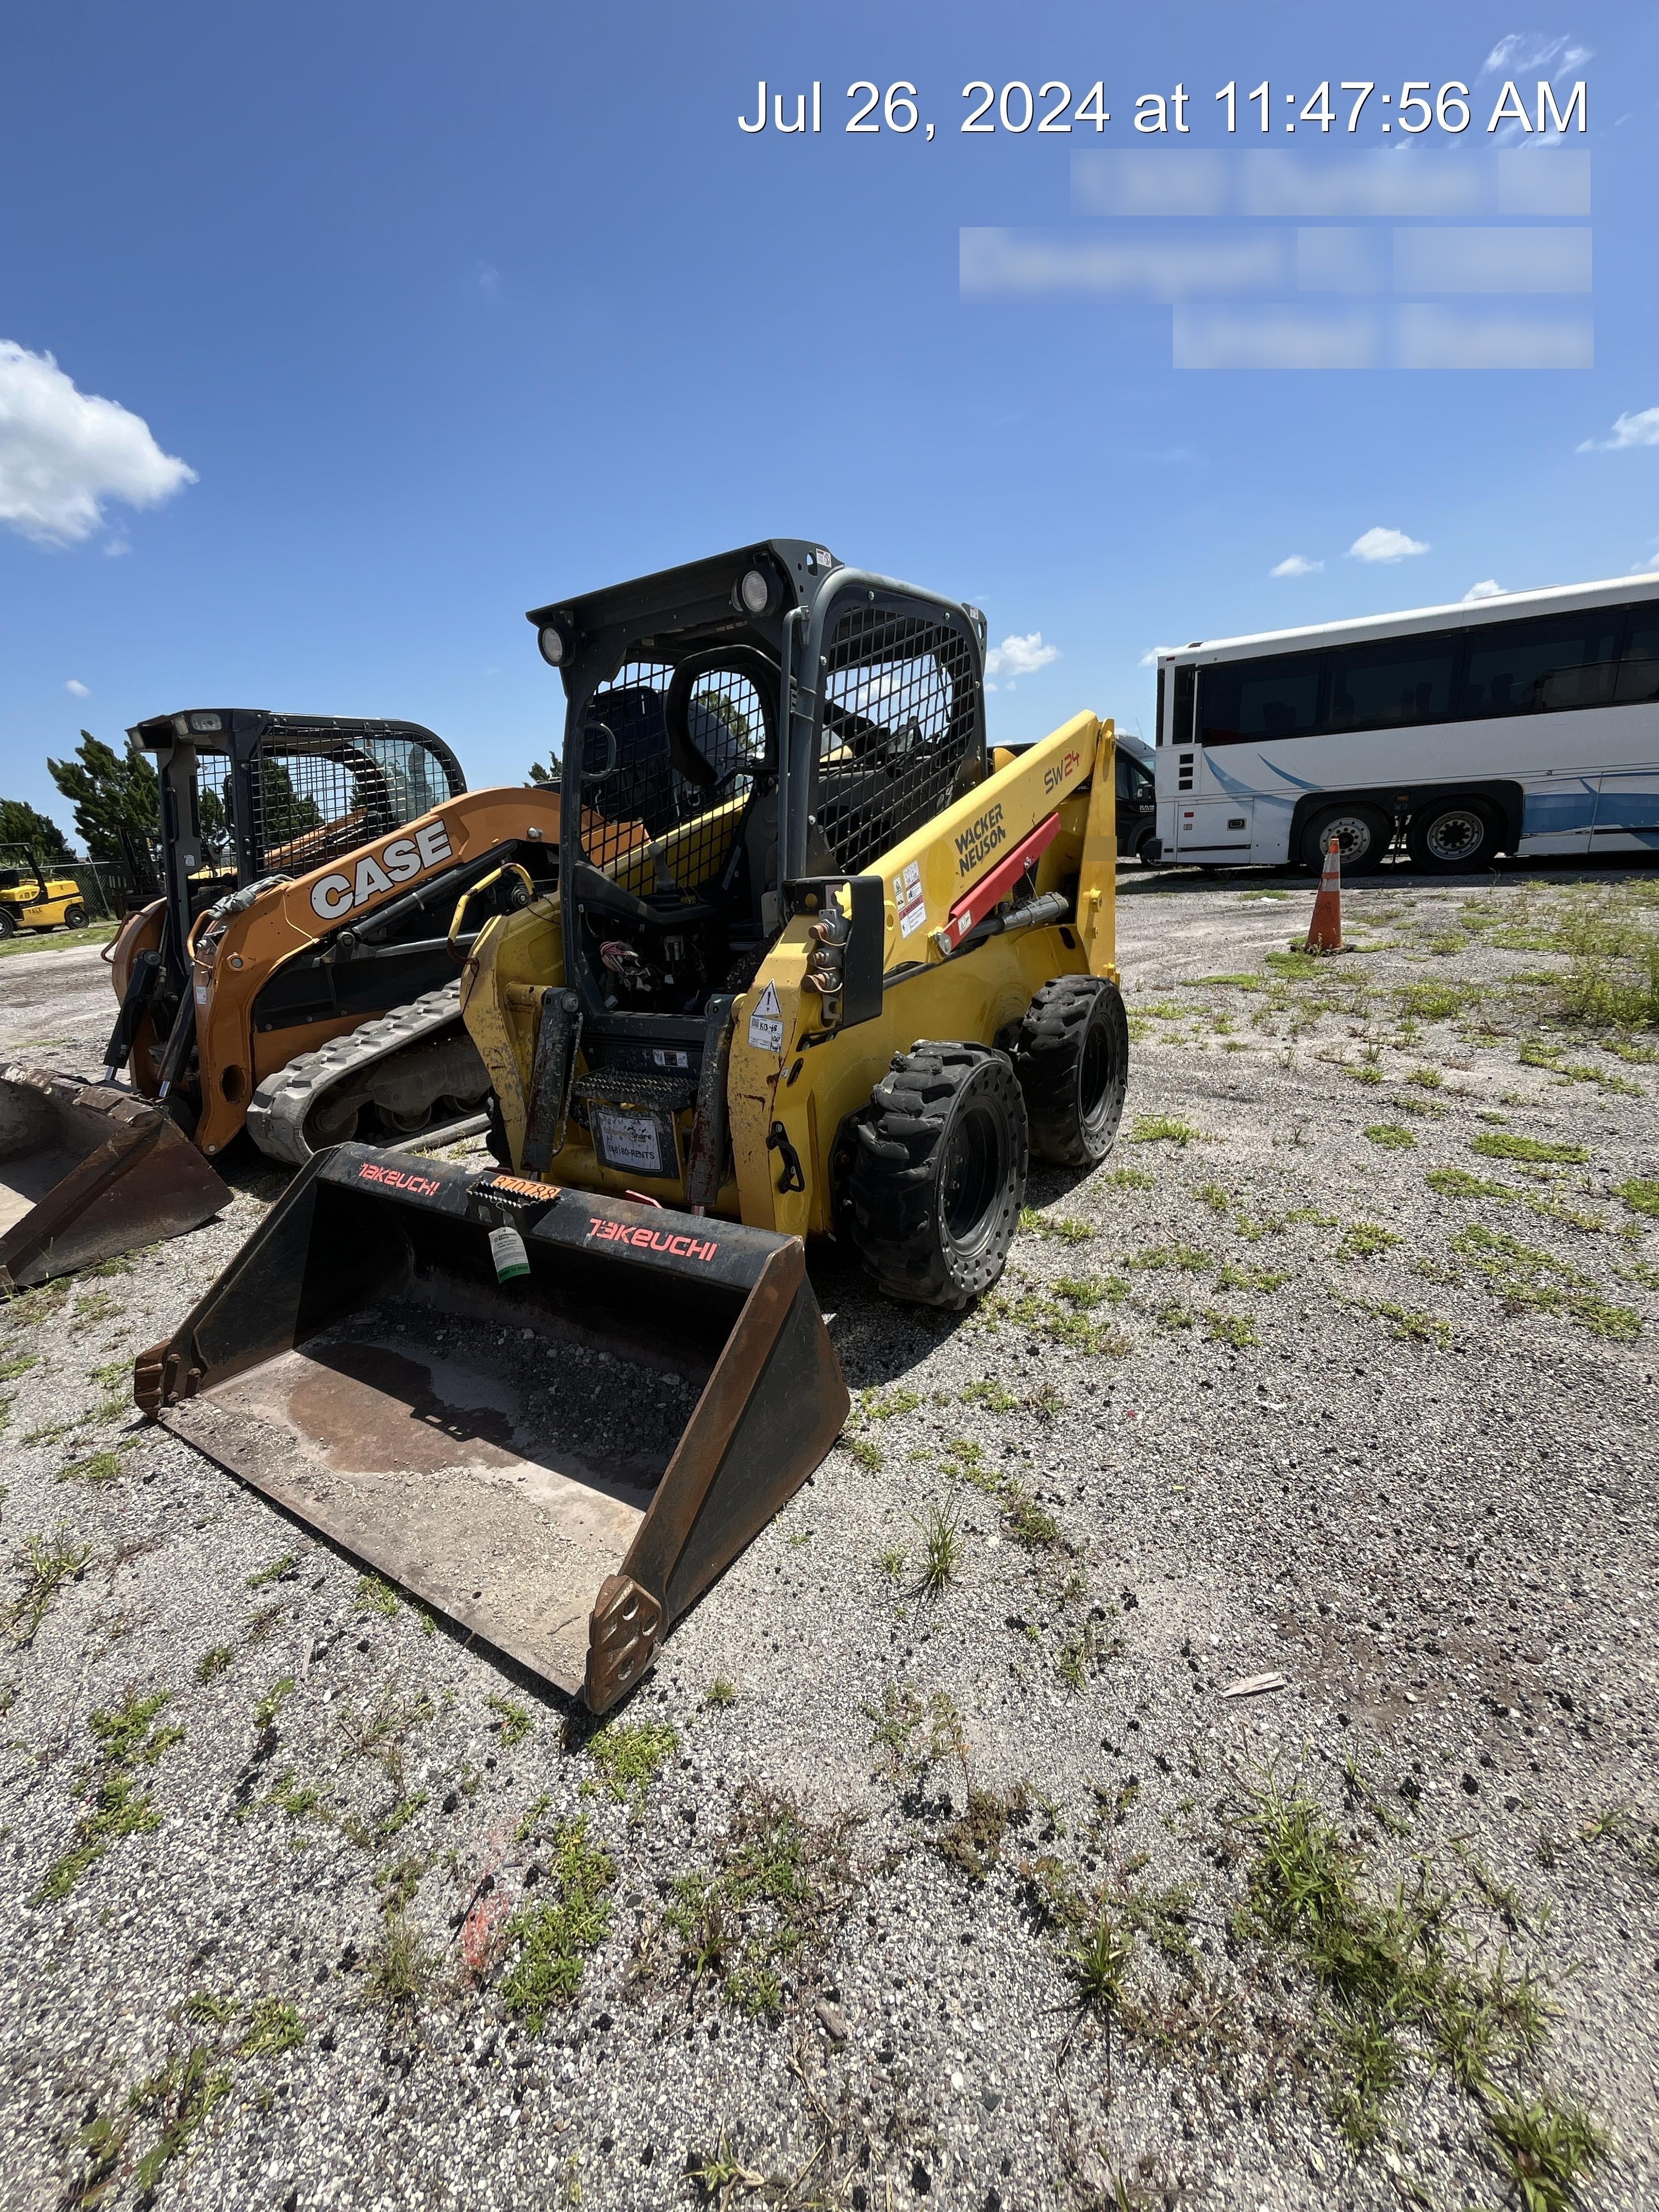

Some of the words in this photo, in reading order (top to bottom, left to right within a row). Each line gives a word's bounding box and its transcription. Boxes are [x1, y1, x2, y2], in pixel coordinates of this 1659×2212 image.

[1044, 750, 1080, 795] SW24
[954, 803, 1004, 855] WACKER
[958, 825, 1006, 878] NEUSON
[311, 819, 454, 920] CASE
